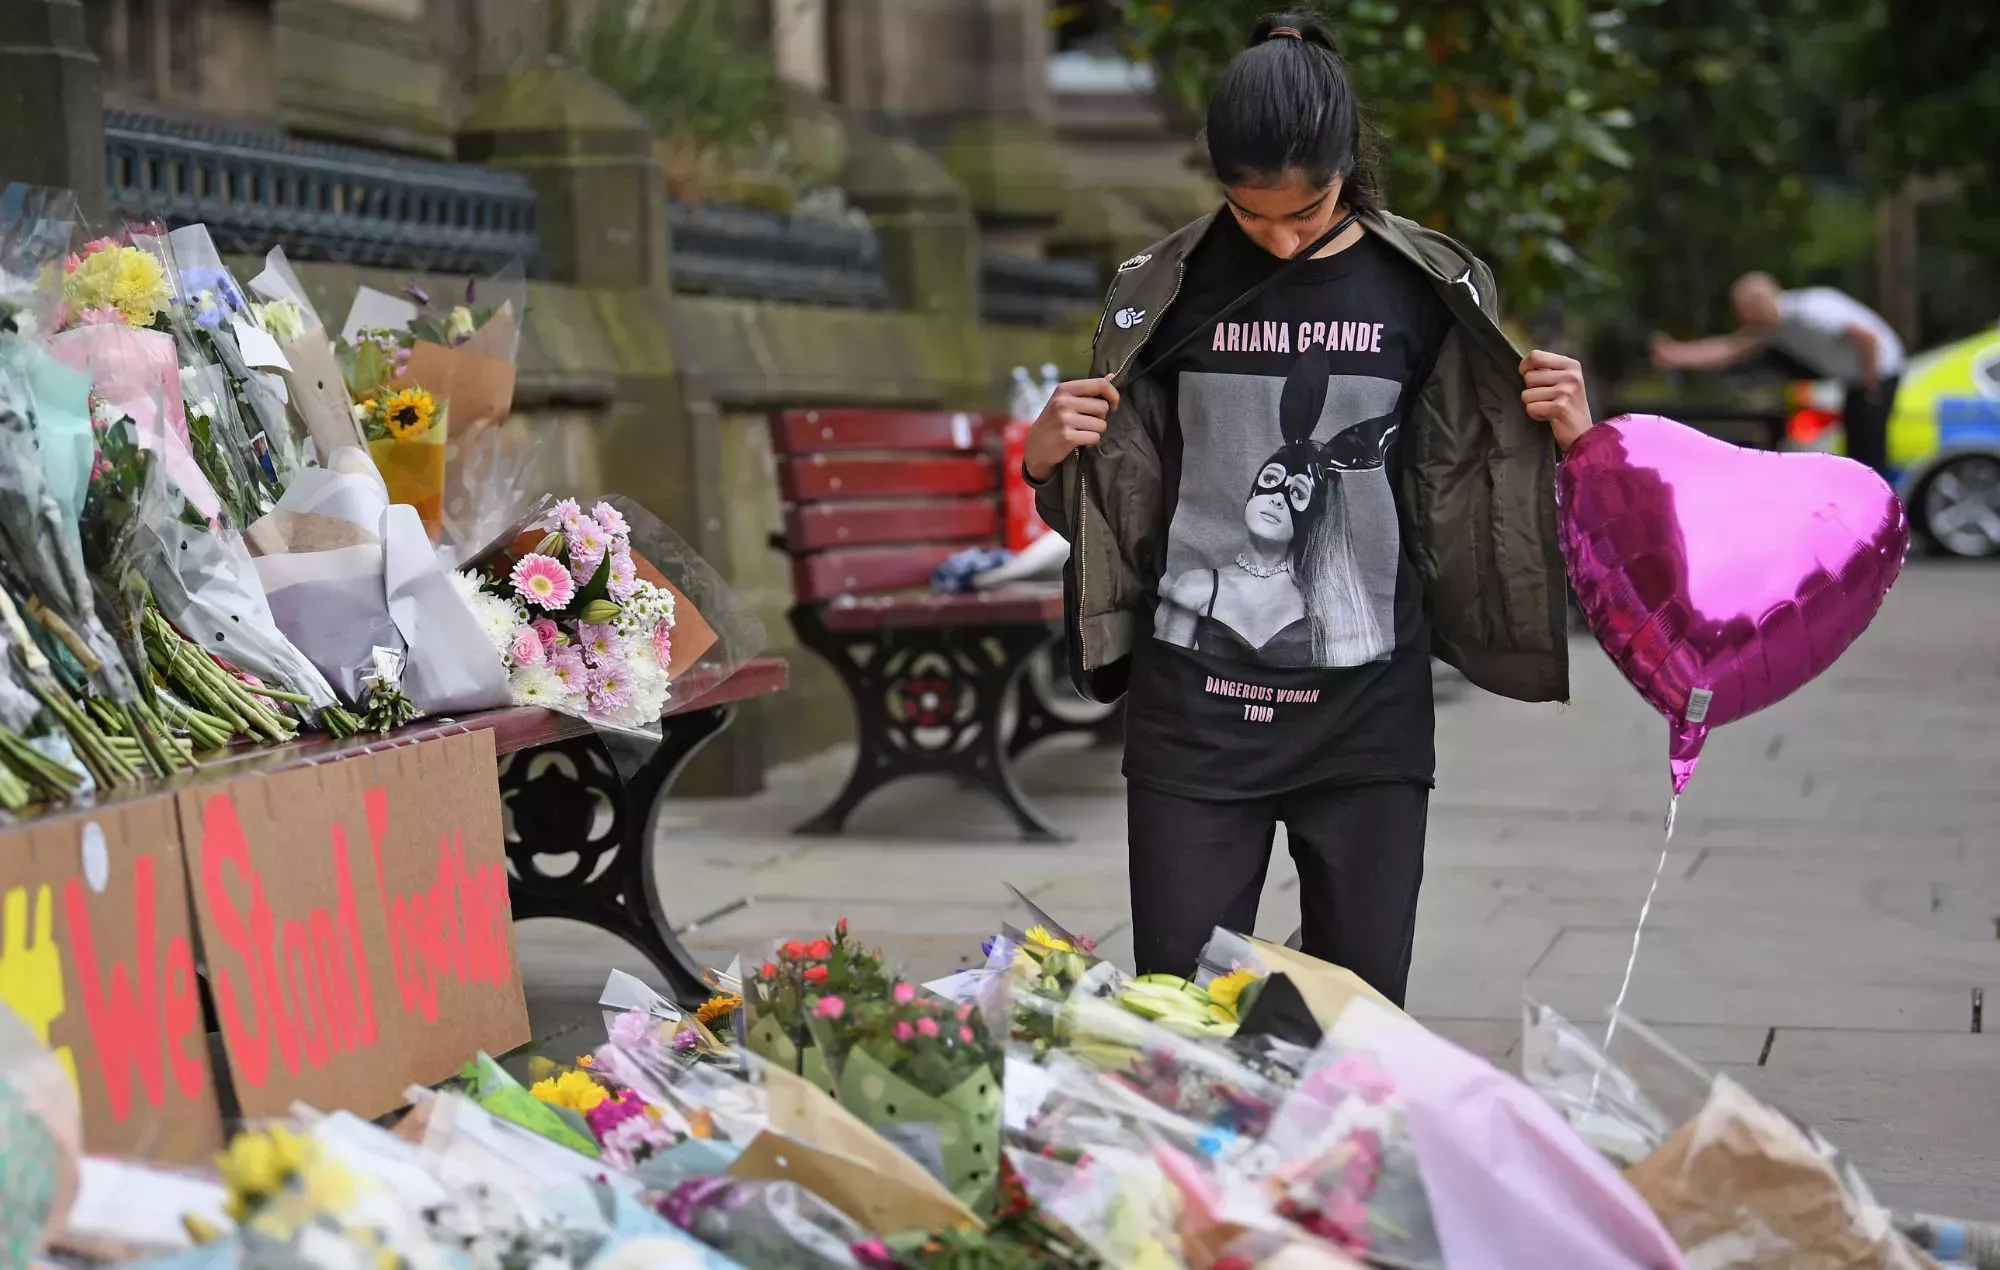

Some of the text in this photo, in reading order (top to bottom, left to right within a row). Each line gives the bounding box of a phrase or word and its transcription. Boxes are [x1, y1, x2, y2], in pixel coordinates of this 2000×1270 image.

[1212, 321, 1384, 353] ARIANA GRANDE
[1205, 675, 1320, 703] DANGEROUS WOMAN
[1244, 704, 1274, 723] TOUR
[63, 786, 512, 1123] We Stand Together
